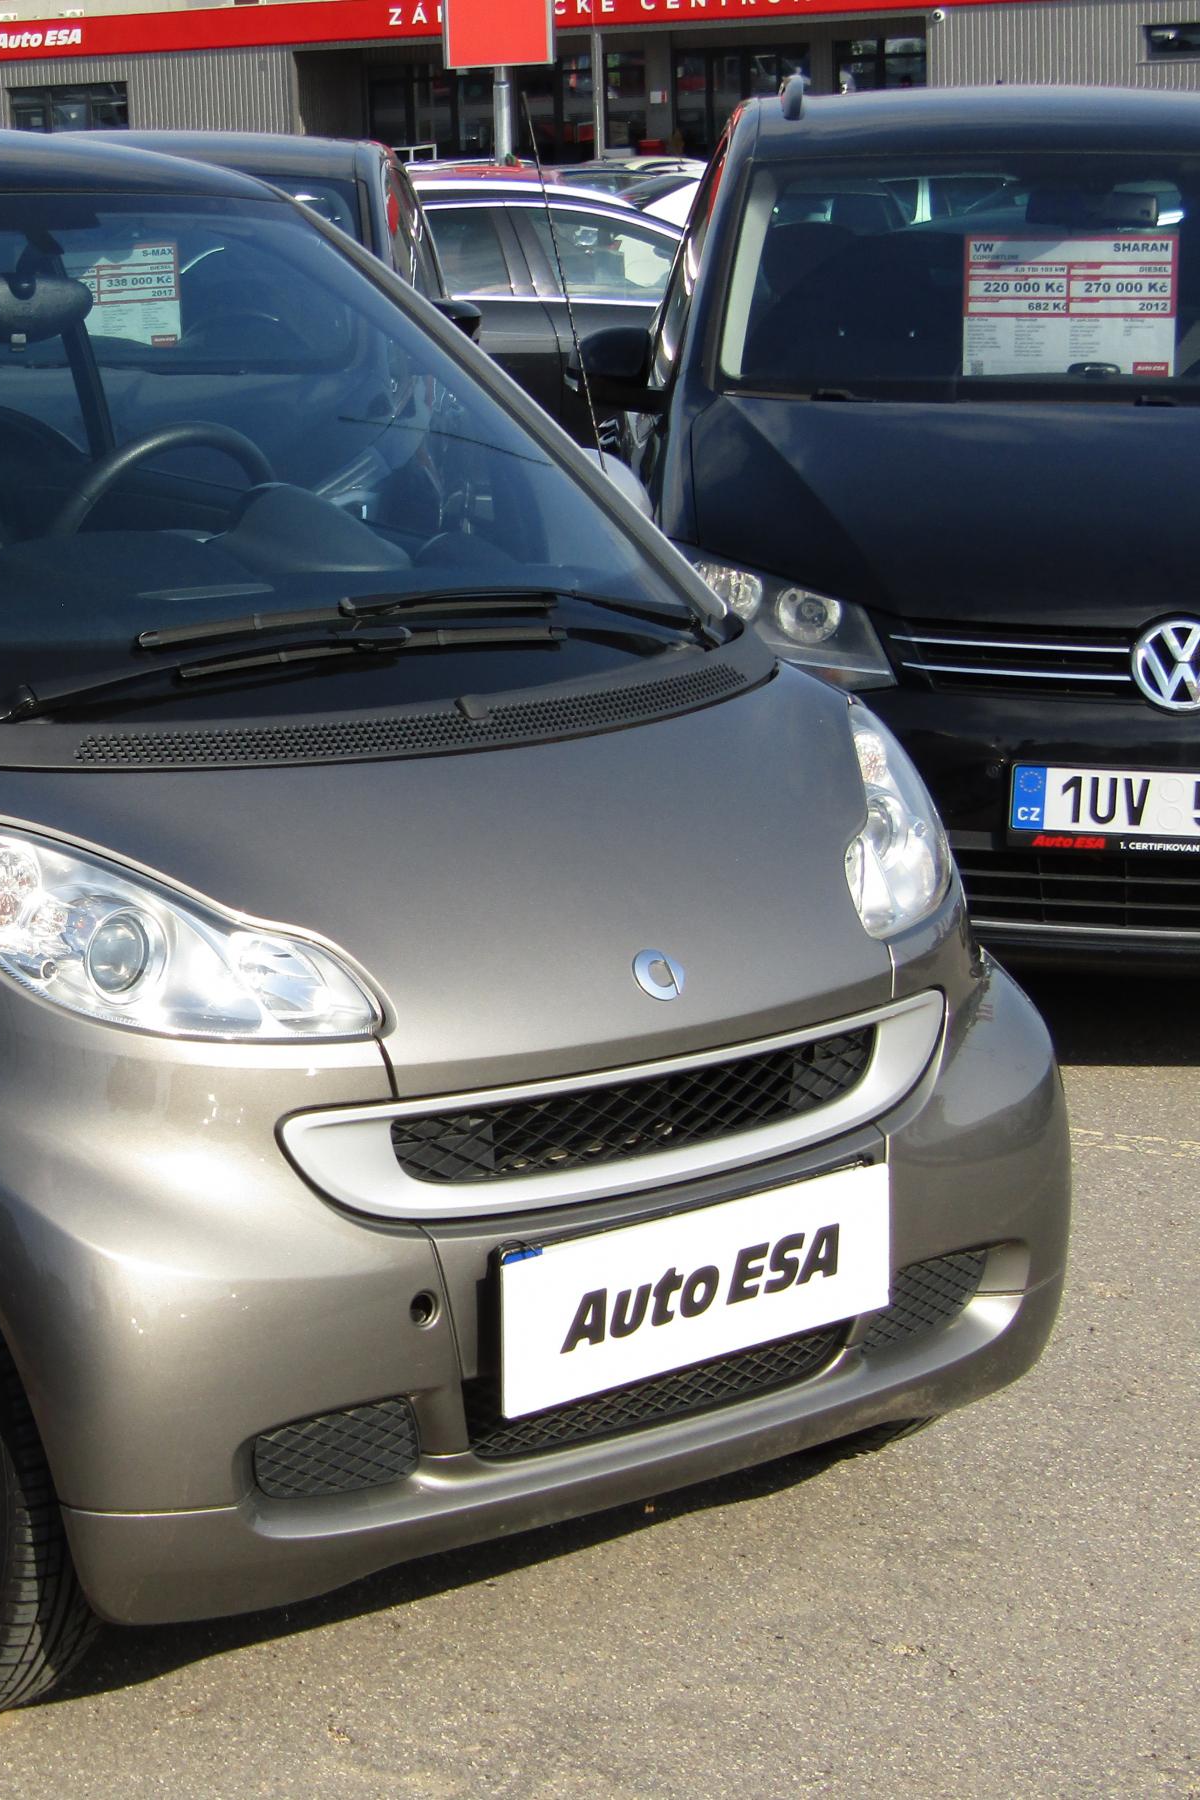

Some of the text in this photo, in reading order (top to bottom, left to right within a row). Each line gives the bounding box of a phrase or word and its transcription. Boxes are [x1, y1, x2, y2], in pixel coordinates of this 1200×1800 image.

[44, 28, 82, 46] ESA
[142, 247, 174, 257] S-MAX
[974, 242, 1169, 252] VW SHARAN
[131, 277, 153, 286] 000
[156, 275, 173, 284] Kč
[983, 282, 1065, 293] 220 000 Kč
[1084, 281, 1168, 293] 270 000 Kč
[151, 289, 173, 297] 2017
[1028, 302, 1049, 311] 682
[1139, 302, 1168, 311] 2012
[1061, 776, 1151, 826] 1UV
[1017, 807, 1041, 821] CZ
[1032, 835, 1106, 849] Auto ESA
[1120, 841, 1200, 852] 1. CERTIFIKOVAN
[560, 1223, 839, 1354] Auto ESA
